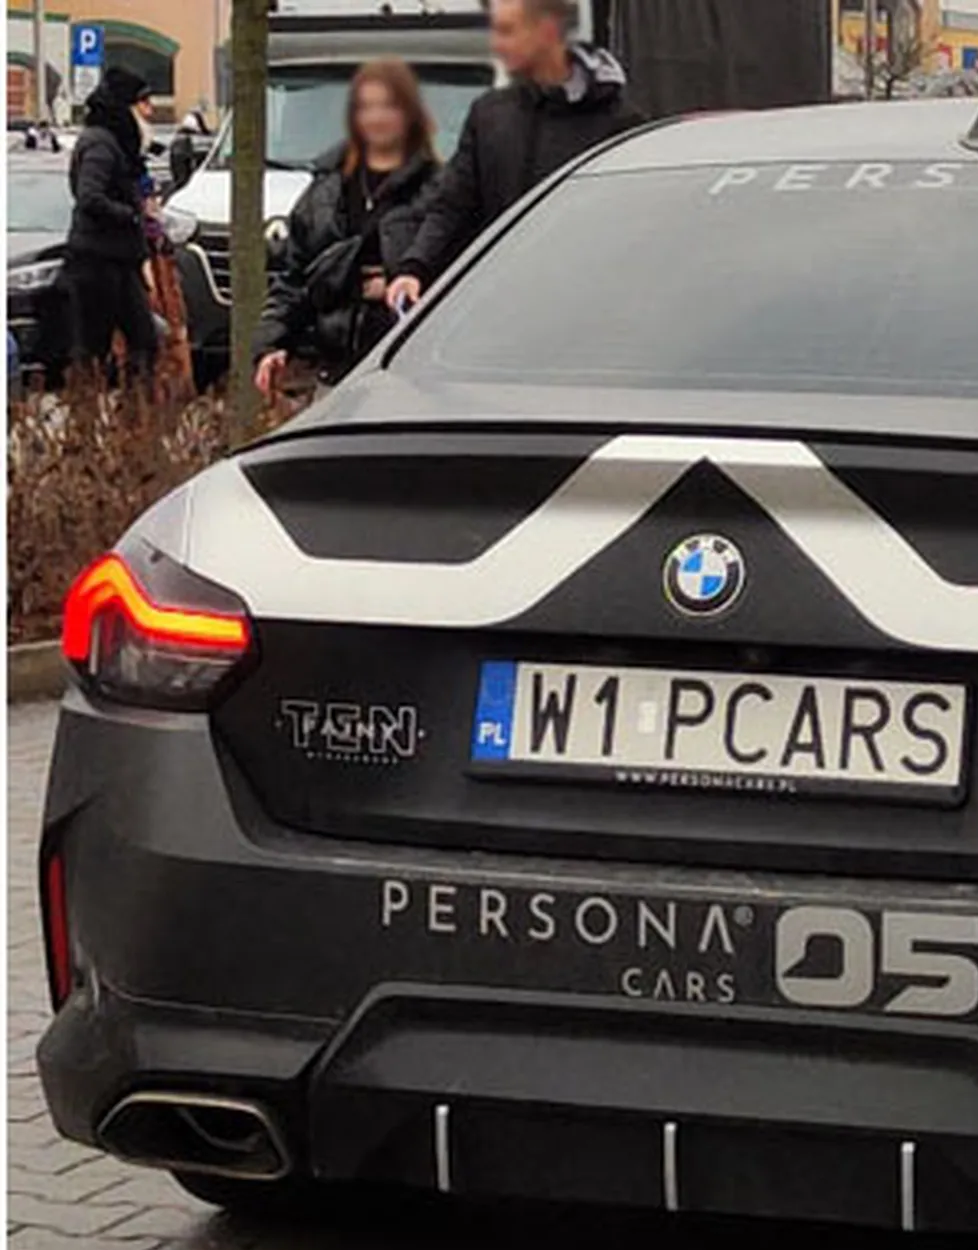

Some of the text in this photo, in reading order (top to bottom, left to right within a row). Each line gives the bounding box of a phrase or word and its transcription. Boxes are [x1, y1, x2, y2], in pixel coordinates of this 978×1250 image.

[81, 28, 97, 53] P
[478, 673, 953, 776] PL W1 PCARS
[382, 879, 735, 955] PERSONA
[621, 965, 736, 1004] CARS
